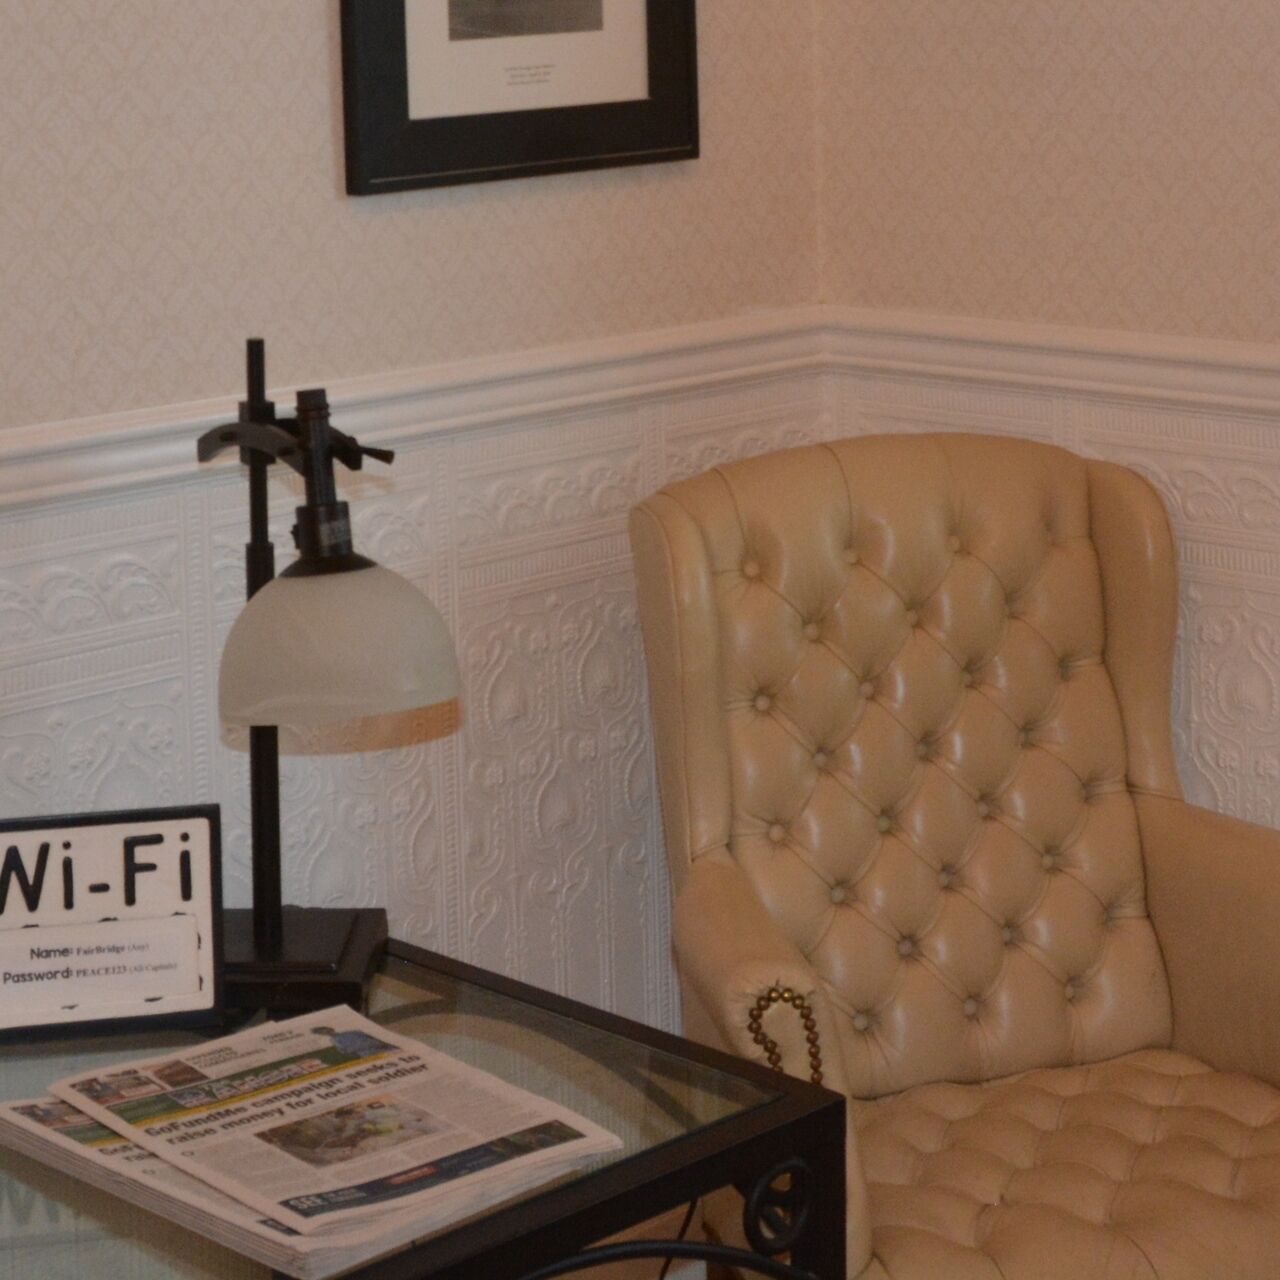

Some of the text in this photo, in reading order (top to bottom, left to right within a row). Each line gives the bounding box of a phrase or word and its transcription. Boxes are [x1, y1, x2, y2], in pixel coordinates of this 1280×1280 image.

[3, 967, 73, 984] Password:
[75, 965, 127, 978] PEACE123
[30, 946, 75, 960] Name:
[76, 943, 125, 956] FairBridge
[144, 1104, 247, 1136] GoFundMe
[251, 1077, 343, 1108] campaign
[347, 1060, 397, 1080] seeks
[399, 1053, 421, 1066] to
[167, 1061, 430, 1146] raise money for local soldier
